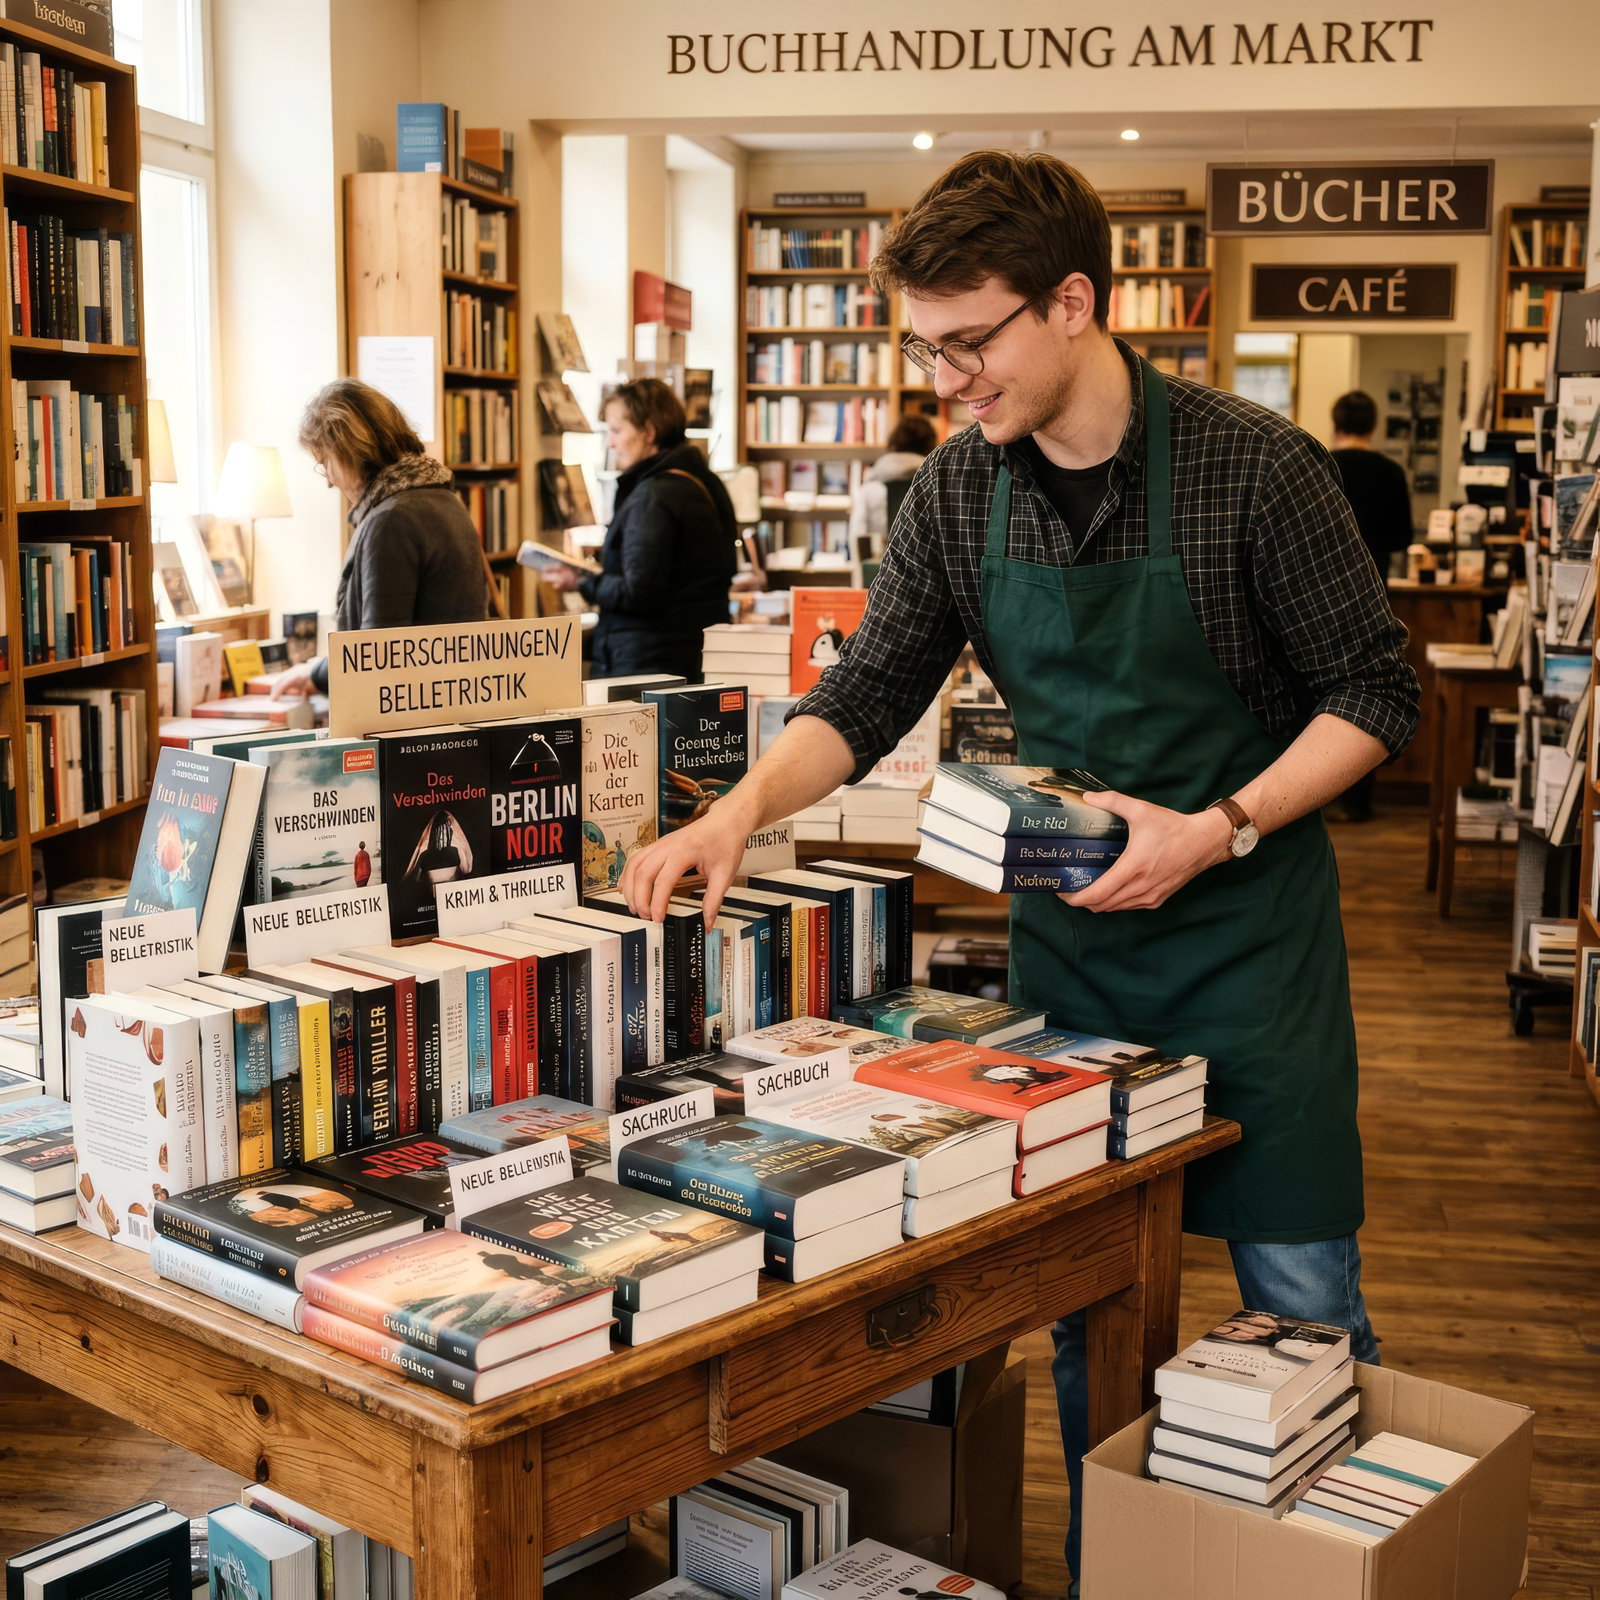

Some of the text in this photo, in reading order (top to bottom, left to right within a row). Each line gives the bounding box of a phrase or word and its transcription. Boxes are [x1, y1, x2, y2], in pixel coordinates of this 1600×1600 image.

[667, 19, 1434, 75] BUCHHANDLUNG AM MARKT
[1238, 171, 1459, 223] BÜCHER
[1298, 269, 1408, 313] CAFÉ
[343, 622, 572, 674] NEUERSCHEINUNGEN/
[379, 672, 527, 714] BELLETRISTIK
[602, 749, 639, 771] Welt
[313, 790, 338, 808] DAS
[491, 784, 577, 827] BERLIN
[588, 791, 645, 813] Karten
[274, 805, 376, 834] VERSCHWINDEN
[506, 822, 564, 861] NOIR
[445, 874, 566, 910] KRIMI & THRILLER
[109, 923, 145, 942] NEUE
[252, 896, 382, 934] NEUE BELLETRISTIK
[110, 937, 194, 963] BELLETRISTIK
[757, 1061, 830, 1096] SACHBUCH
[461, 1172, 496, 1193] NEUE
